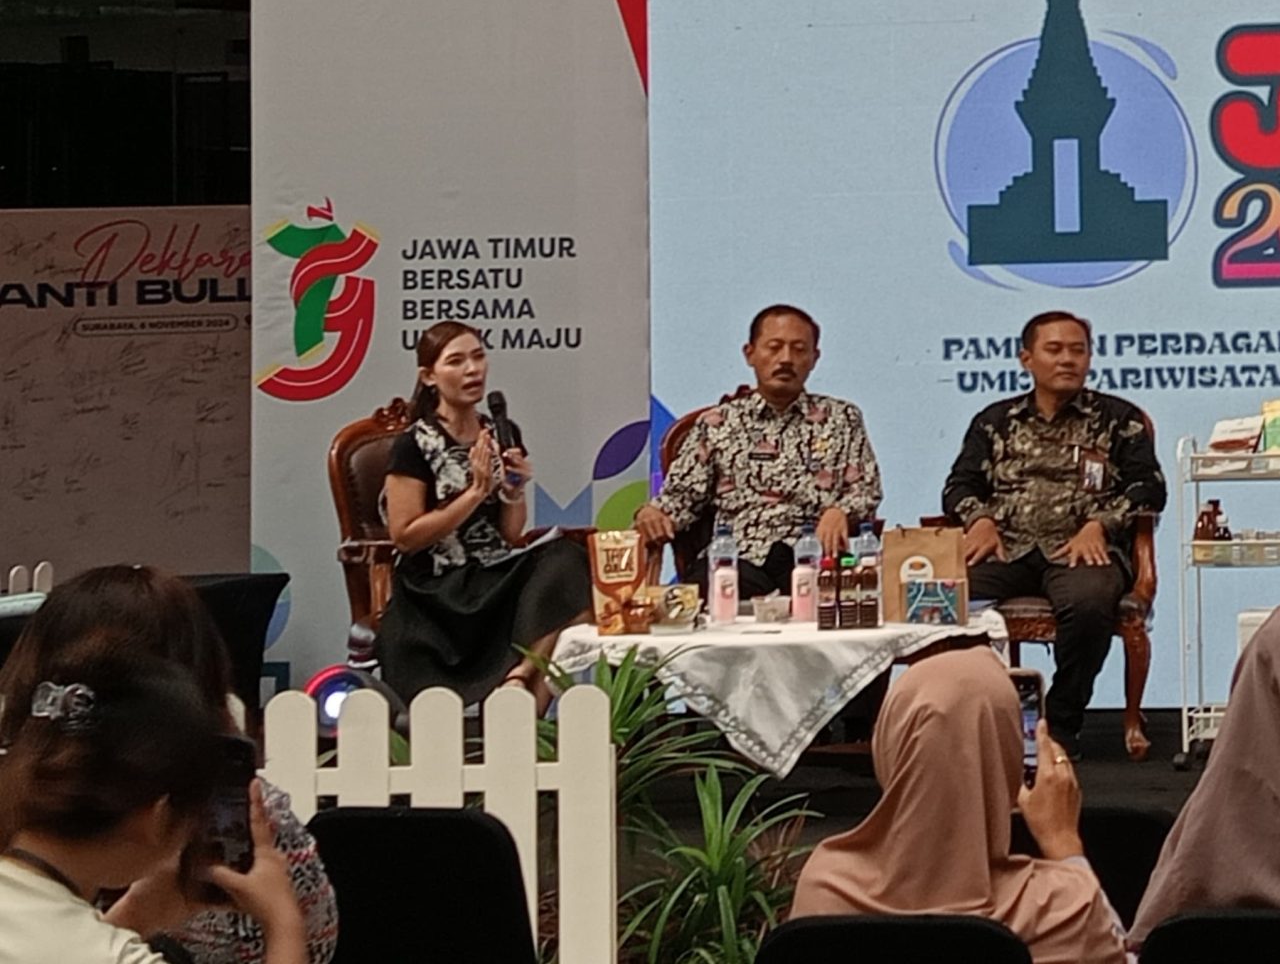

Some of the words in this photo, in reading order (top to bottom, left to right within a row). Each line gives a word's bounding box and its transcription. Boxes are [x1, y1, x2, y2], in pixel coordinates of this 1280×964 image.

[402, 239, 480, 261] JAWA
[488, 237, 577, 259] TIMUR
[402, 268, 523, 290] BERSATU
[0, 280, 118, 308] ANTI
[402, 298, 535, 320] BERSAMA
[148, 319, 203, 330] NOVEMBER
[206, 318, 231, 328] 2024
[501, 328, 582, 349] MAJU
